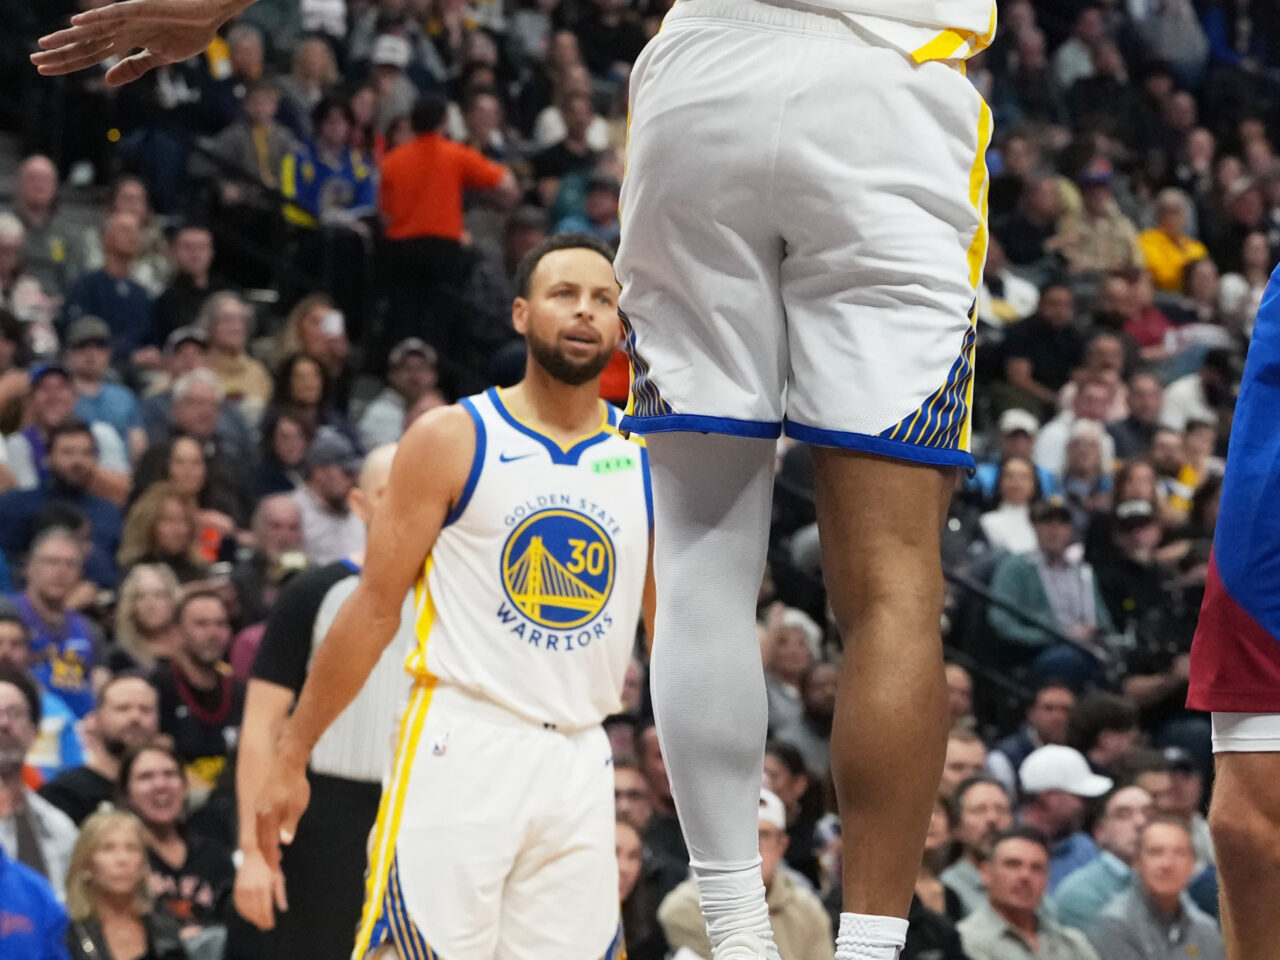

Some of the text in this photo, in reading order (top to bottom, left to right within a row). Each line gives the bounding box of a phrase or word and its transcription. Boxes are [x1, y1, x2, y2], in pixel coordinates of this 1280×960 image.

[504, 492, 621, 537] GOLDEN STATE
[566, 538, 606, 576] 30
[496, 601, 613, 651] WARRIORS
